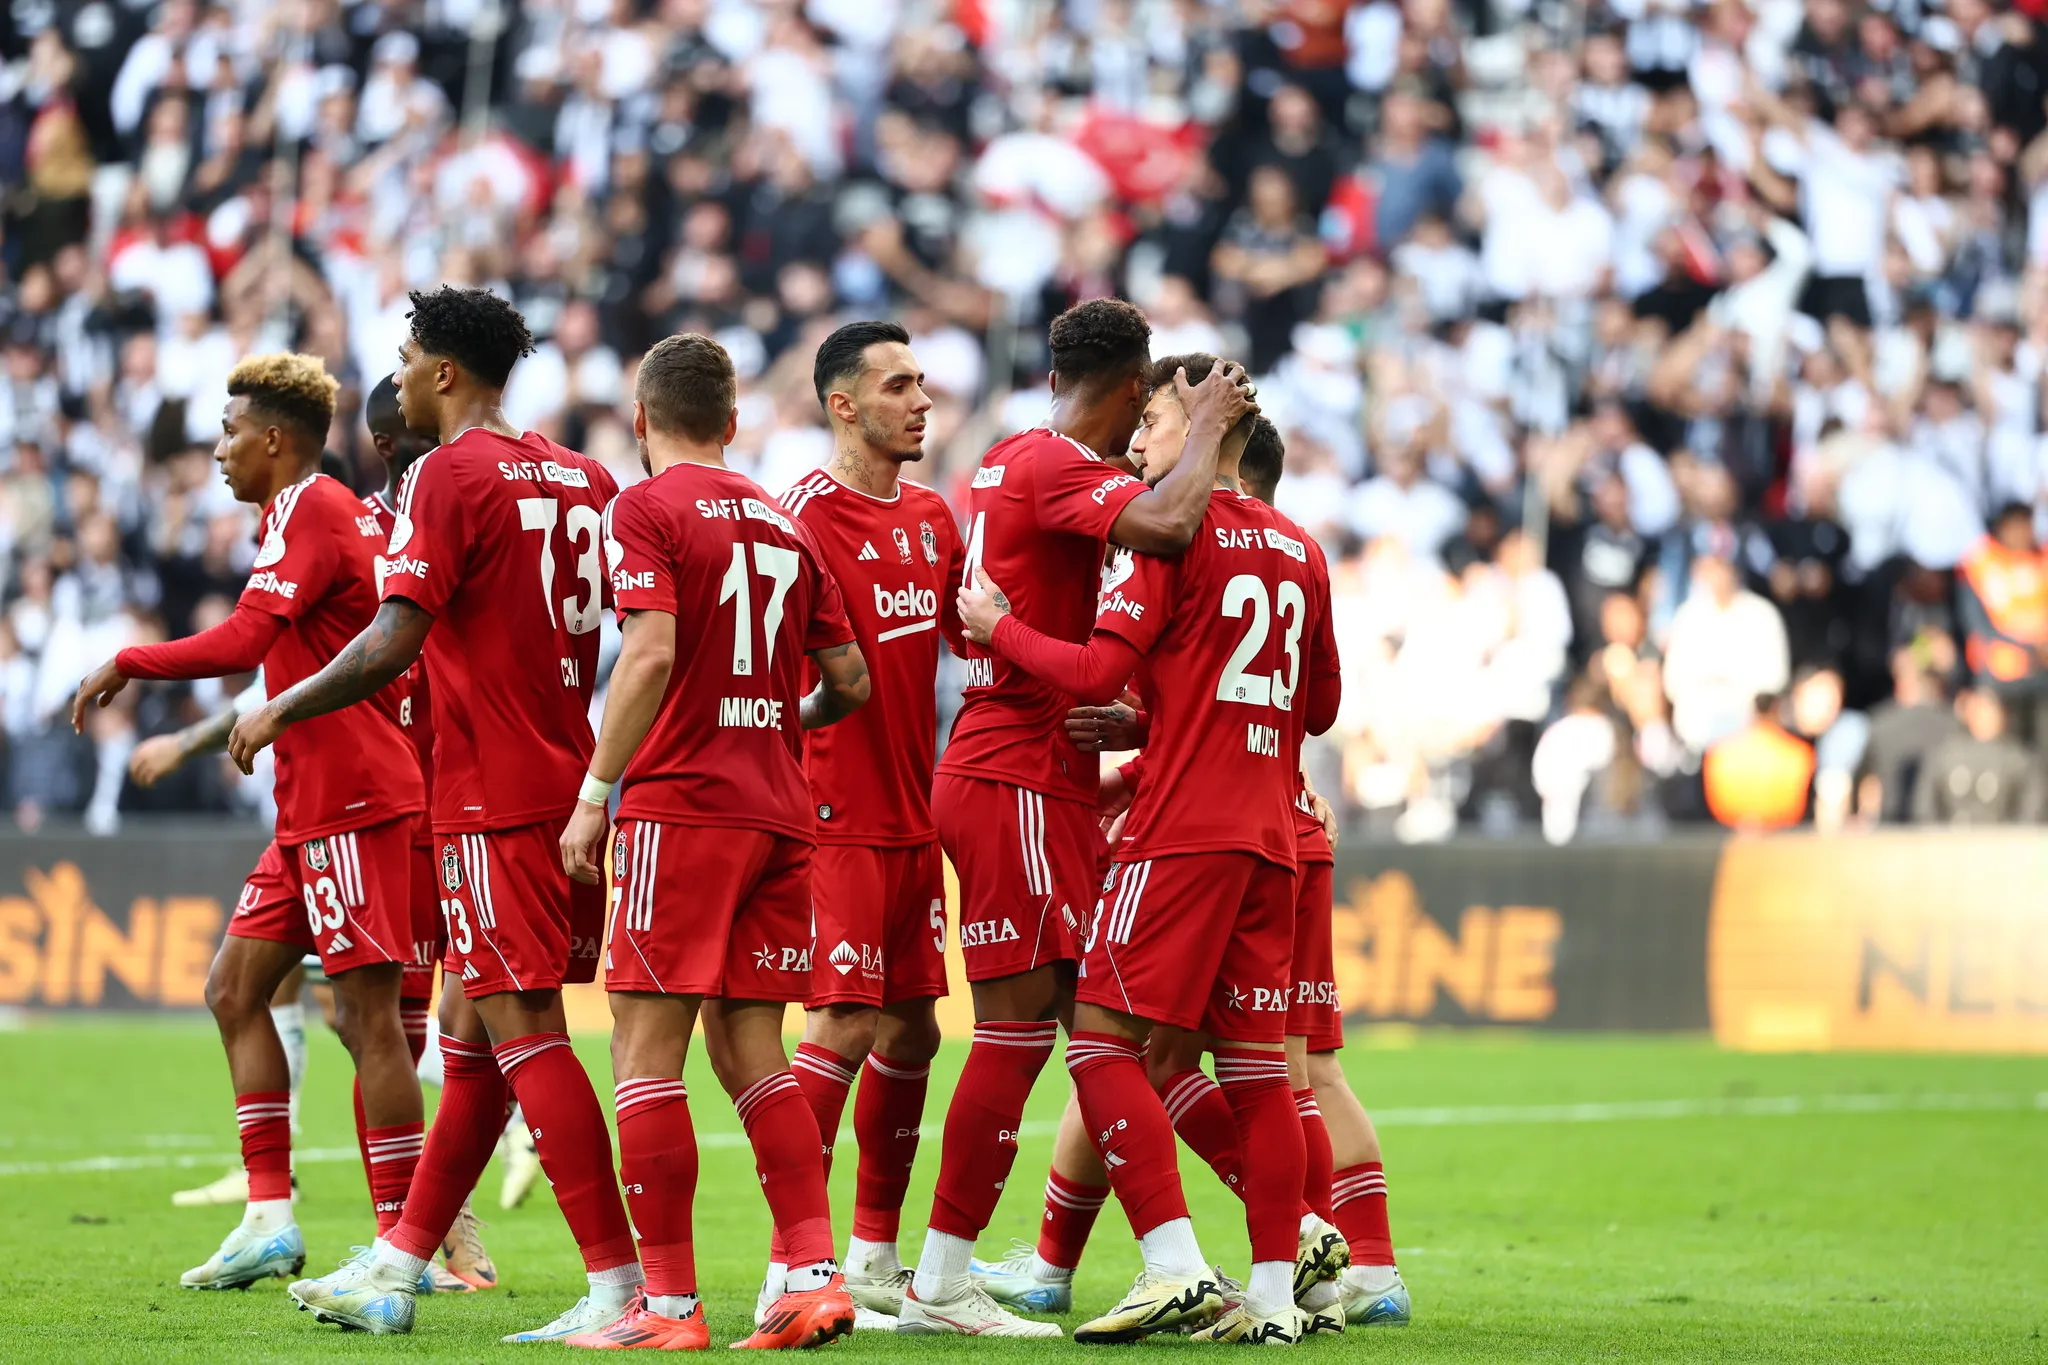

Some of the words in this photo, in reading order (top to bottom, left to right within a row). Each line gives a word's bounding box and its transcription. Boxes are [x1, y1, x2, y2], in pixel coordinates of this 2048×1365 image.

[516, 497, 602, 636] 73
[718, 541, 800, 676] 17
[873, 581, 937, 618] beko
[1215, 574, 1306, 712] 23
[1247, 722, 1279, 758] MUCI
[303, 876, 345, 936] 83
[440, 898, 473, 956] 73
[929, 898, 946, 944] 5
[779, 947, 814, 972] PA
[861, 943, 885, 974] BA
